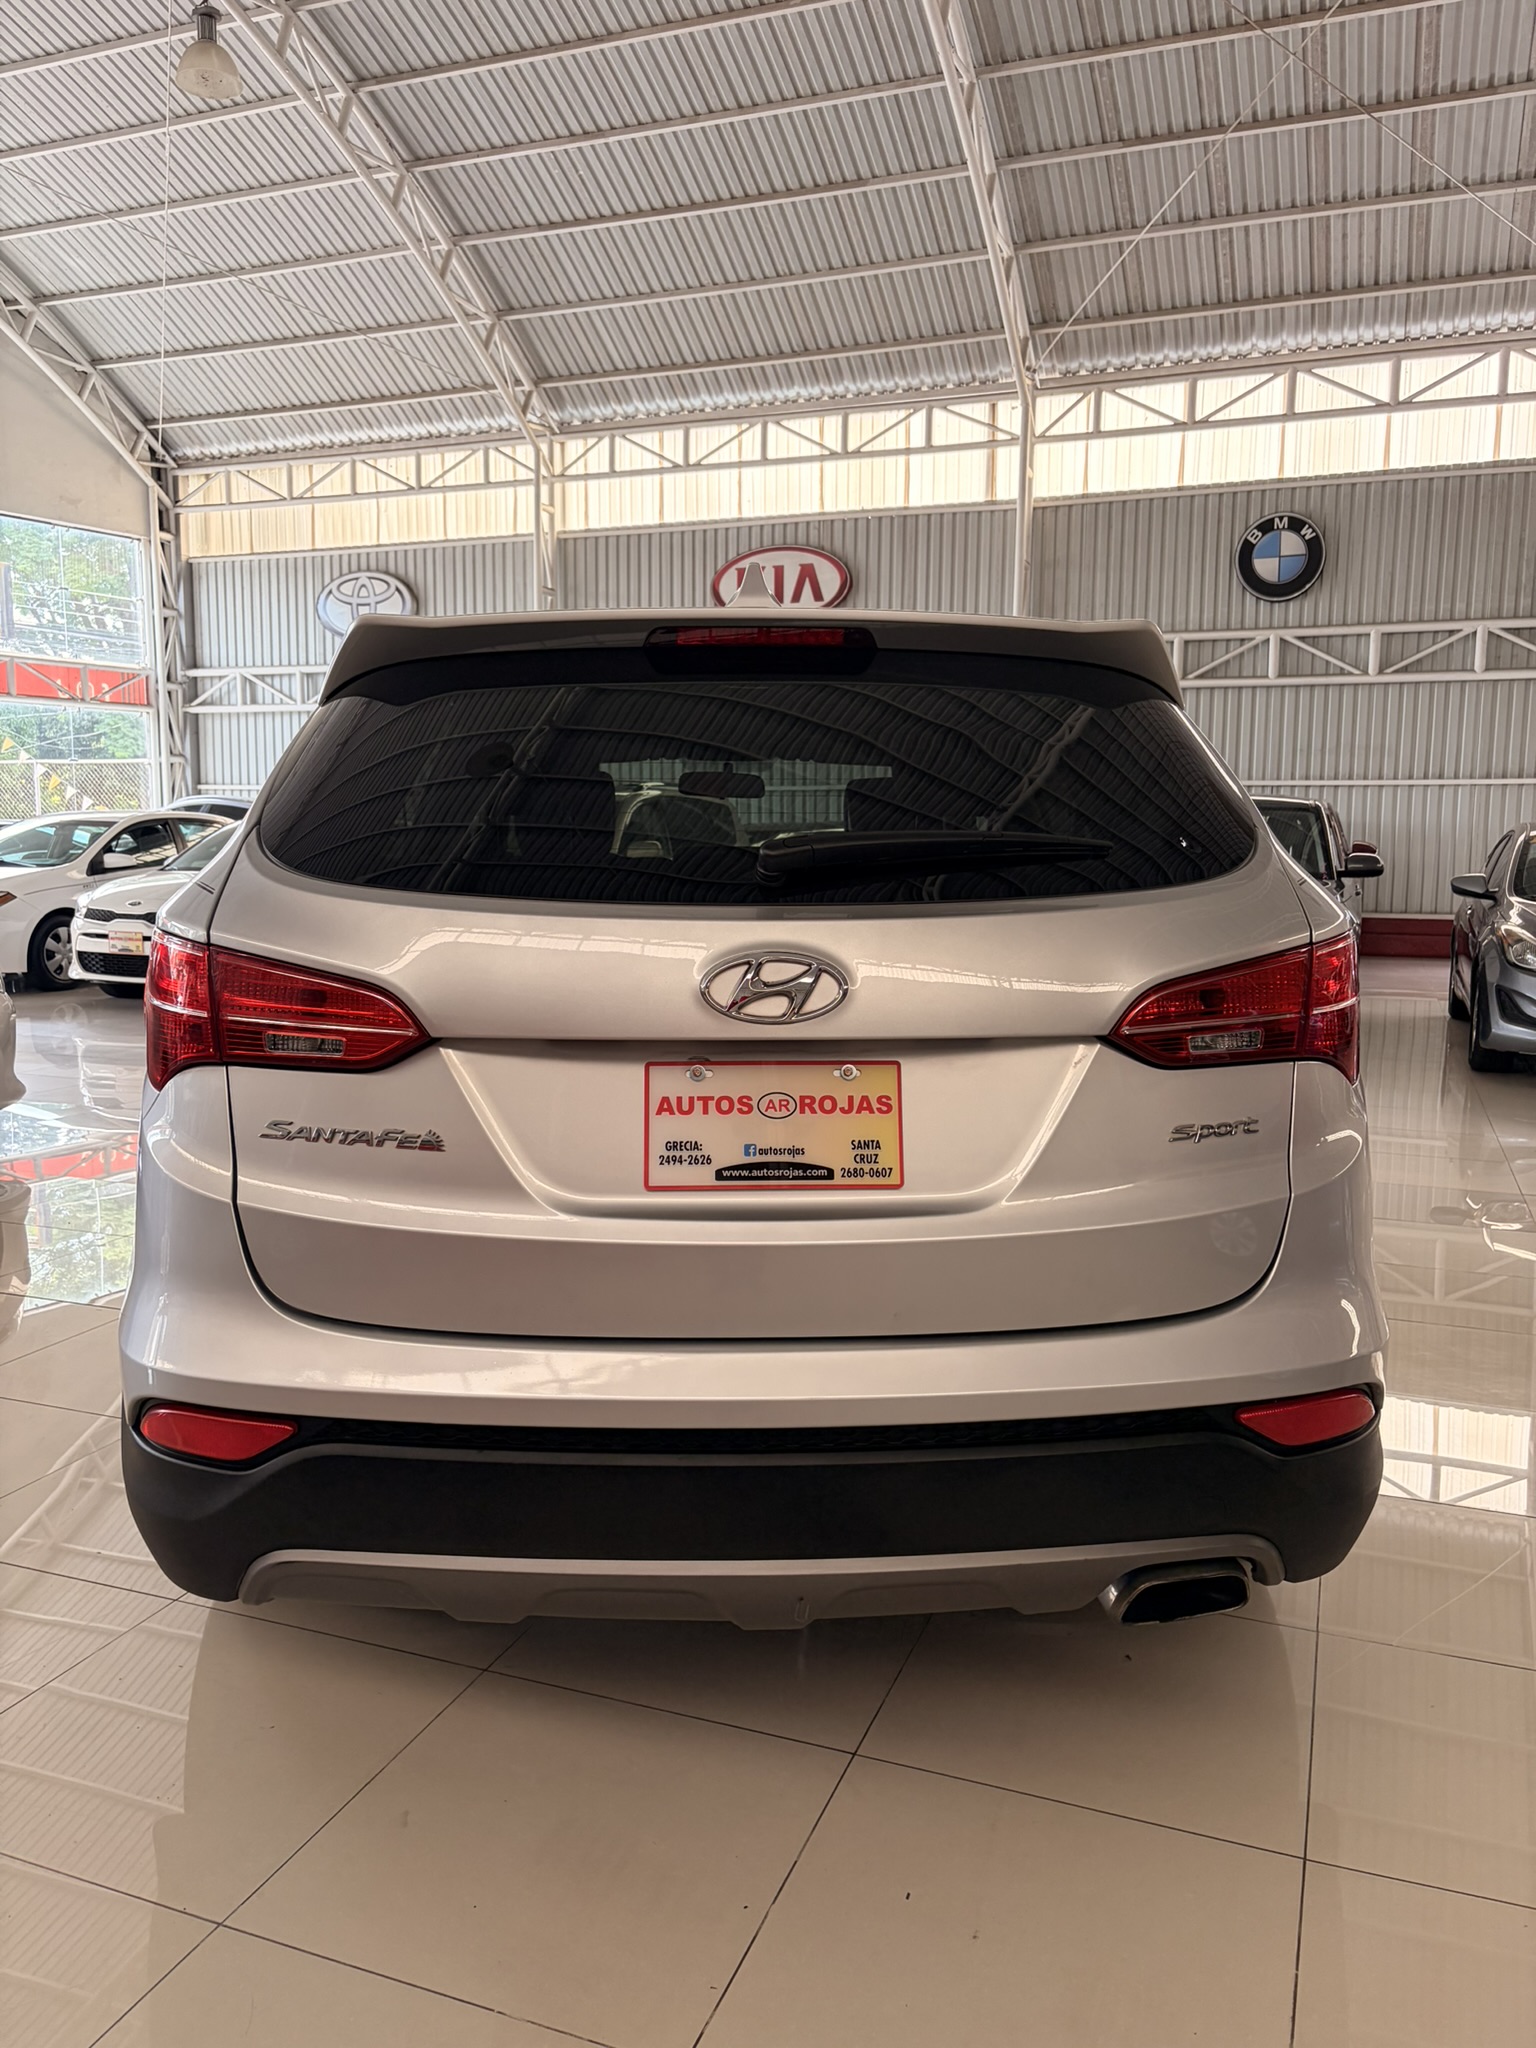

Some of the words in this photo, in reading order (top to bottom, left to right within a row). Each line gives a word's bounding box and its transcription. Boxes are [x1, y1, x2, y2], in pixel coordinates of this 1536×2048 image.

[1246, 516, 1317, 545] BMW
[655, 1095, 754, 1116] AUTOS
[765, 1098, 791, 1113] AR
[798, 1095, 894, 1115] ROJAS
[1168, 1116, 1260, 1144] Sport
[665, 1140, 703, 1152] GRECIA:
[851, 1139, 882, 1151] SANTA
[758, 1145, 806, 1159] autosrojas
[658, 1154, 713, 1166] 2494-2626
[853, 1153, 880, 1164] CRUZ
[721, 1167, 829, 1179] www.autosrojas.com
[840, 1167, 894, 1179] 2680-0607
